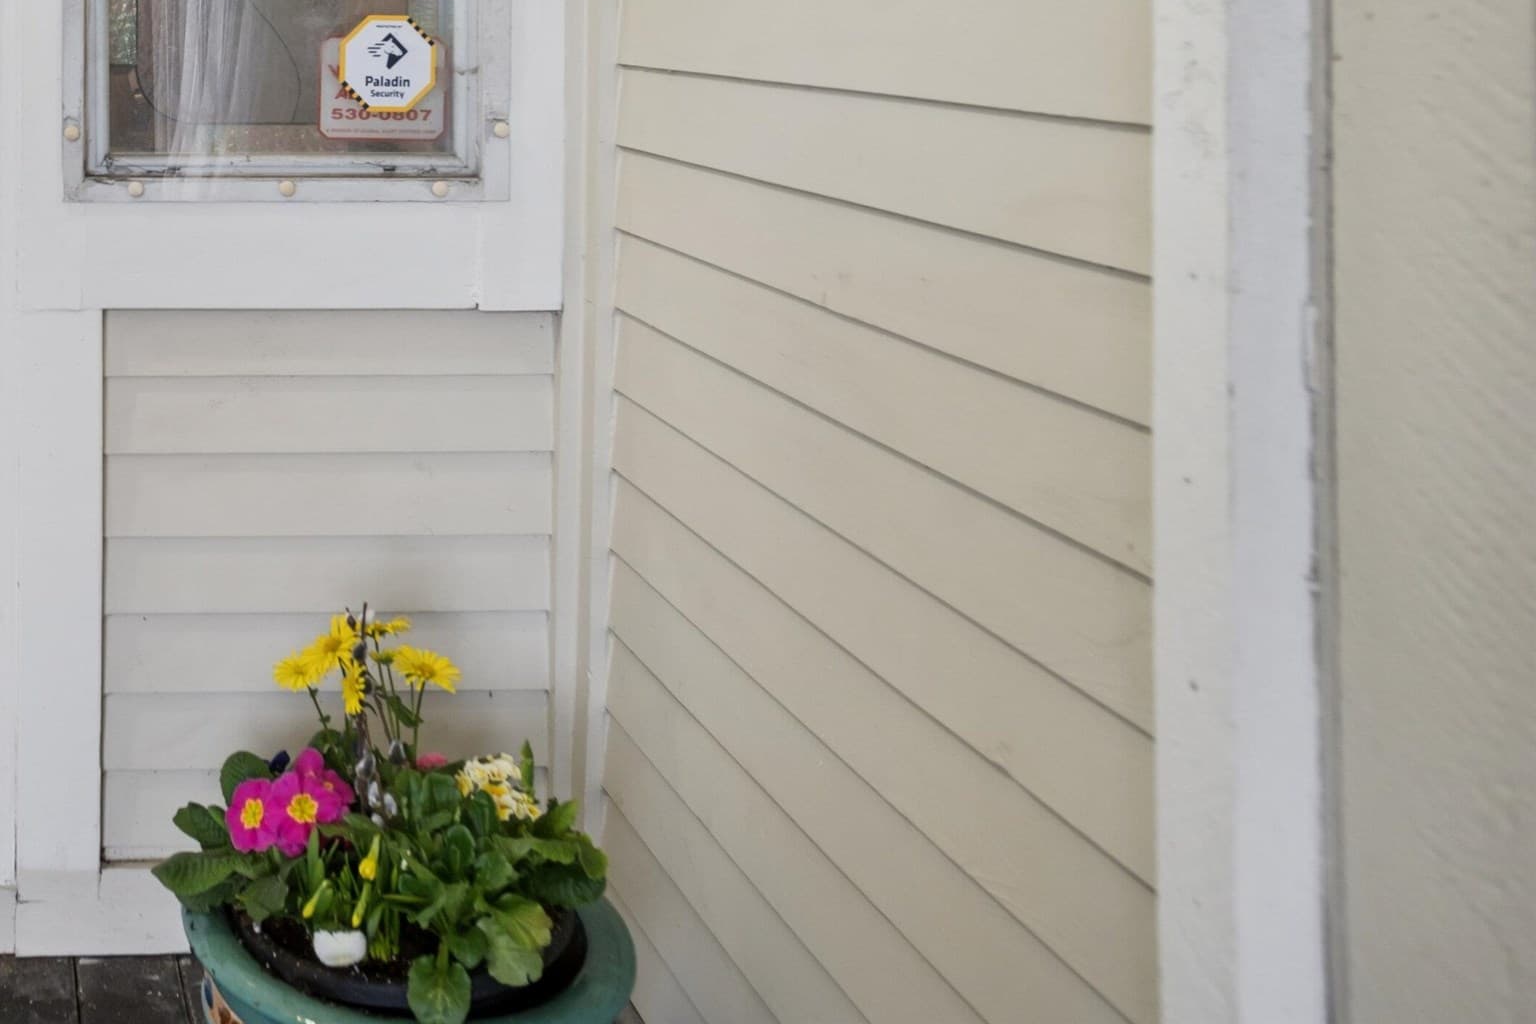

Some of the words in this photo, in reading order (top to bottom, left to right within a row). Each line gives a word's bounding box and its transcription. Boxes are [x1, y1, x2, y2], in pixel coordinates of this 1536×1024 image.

[365, 76, 410, 87] Paladin
[370, 89, 405, 99] Security
[331, 108, 432, 121] 530-0807
